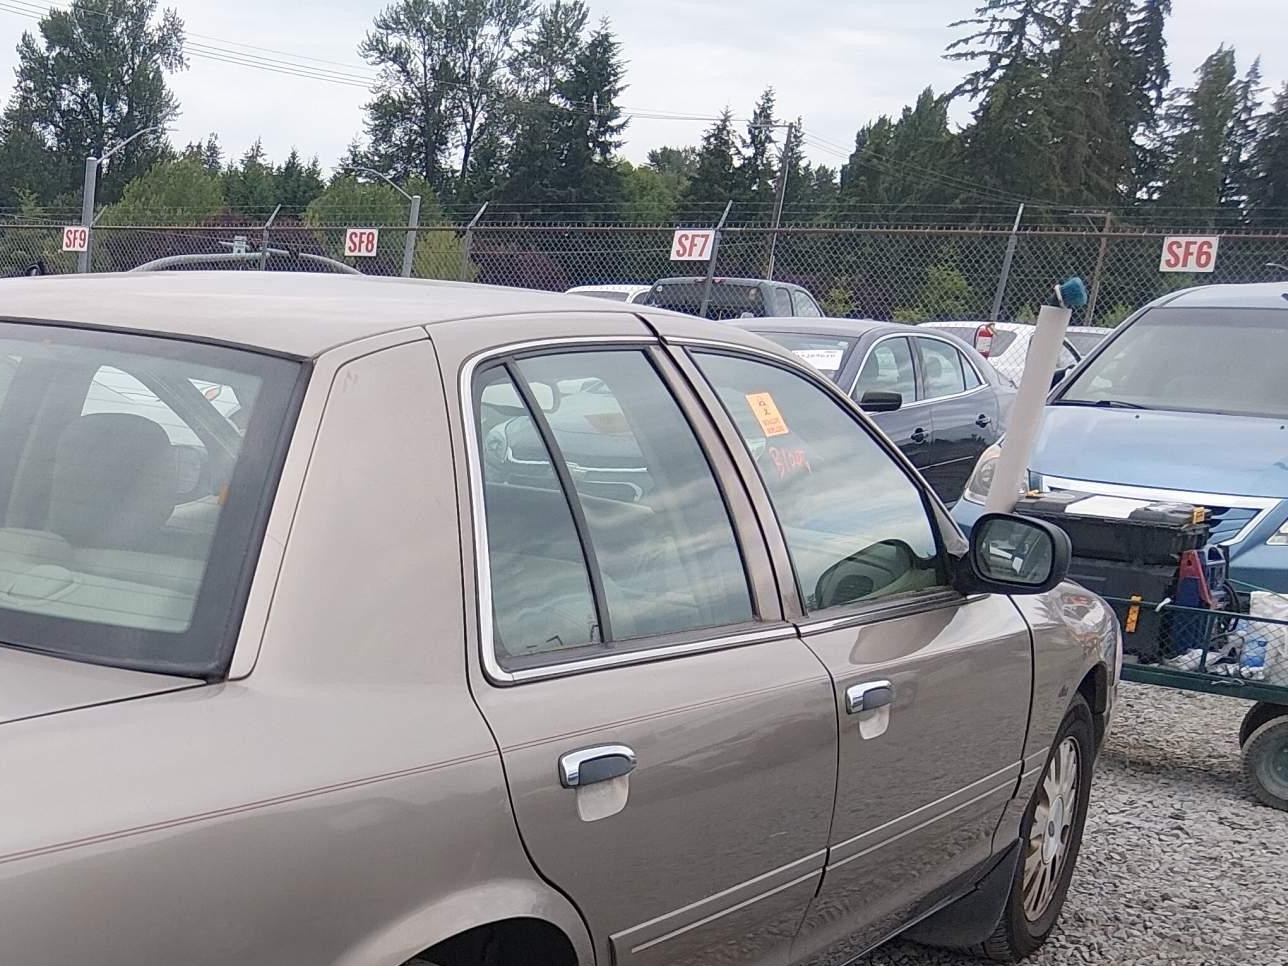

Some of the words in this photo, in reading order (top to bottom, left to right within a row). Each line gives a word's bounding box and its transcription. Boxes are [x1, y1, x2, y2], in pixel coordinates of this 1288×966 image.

[65, 229, 87, 249] SF9
[348, 231, 376, 253] SF8
[675, 233, 711, 257] SF7
[1165, 240, 1213, 269] SF6
